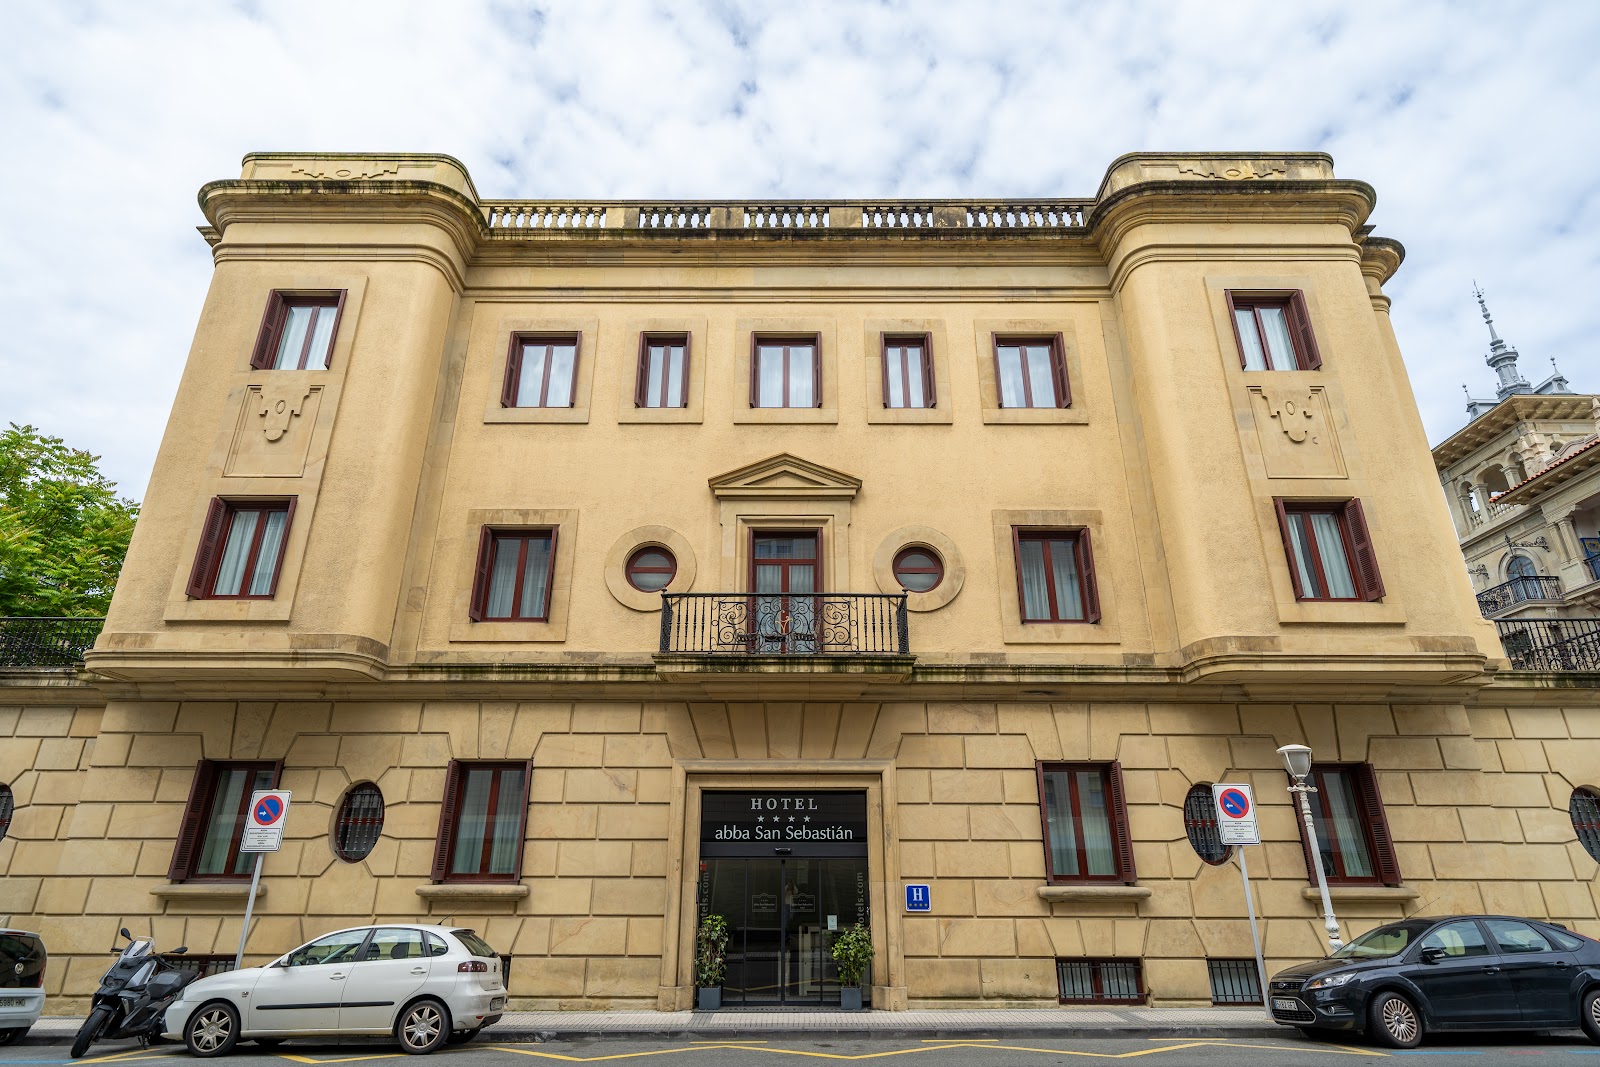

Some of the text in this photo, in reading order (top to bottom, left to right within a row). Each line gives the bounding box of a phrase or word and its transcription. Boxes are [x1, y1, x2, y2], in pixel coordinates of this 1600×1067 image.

[750, 798, 818, 810] HOTEL
[715, 825, 853, 840] abba San Sebastián
[912, 887, 924, 902] H
